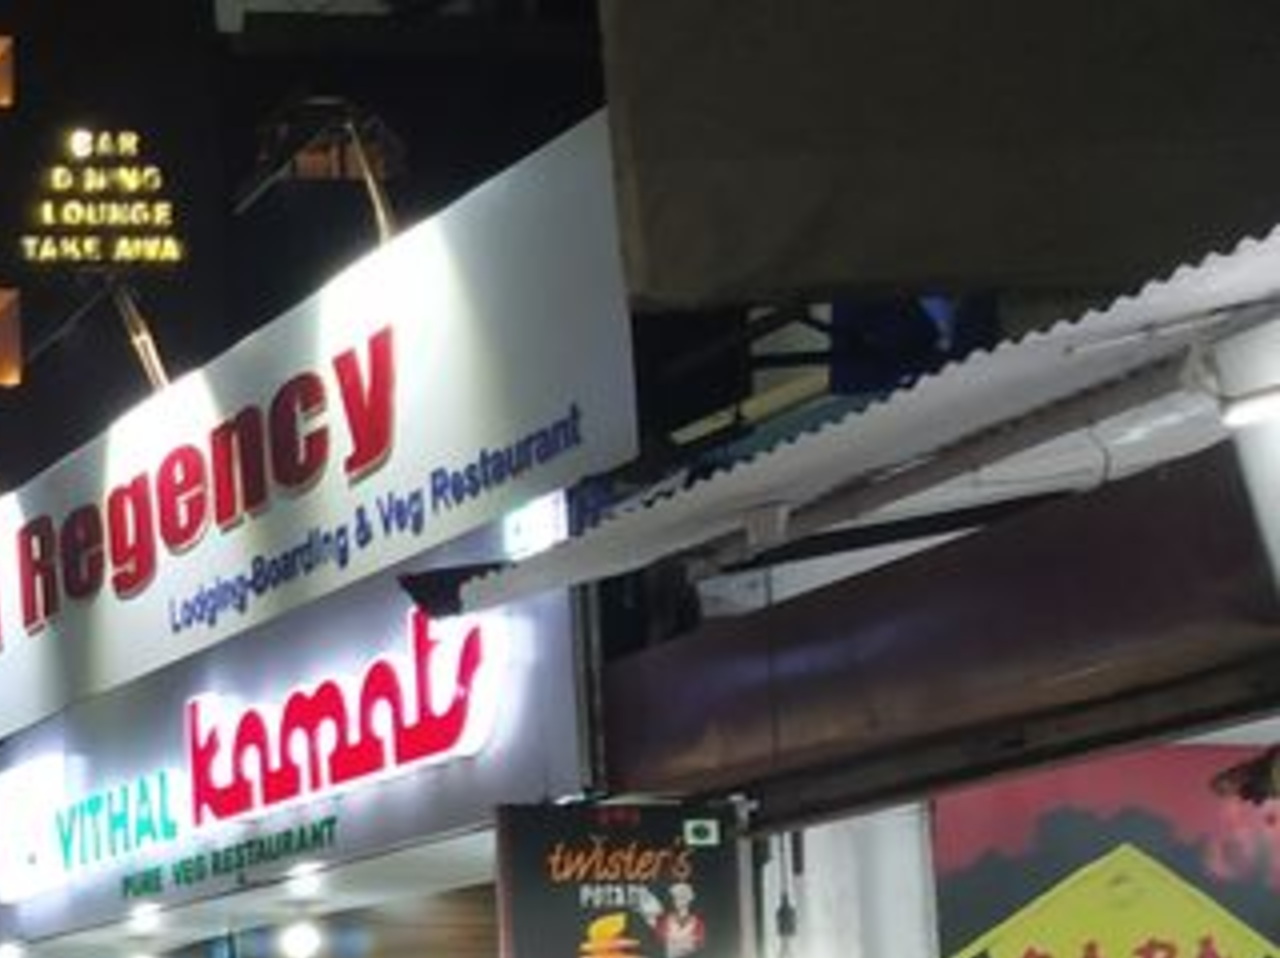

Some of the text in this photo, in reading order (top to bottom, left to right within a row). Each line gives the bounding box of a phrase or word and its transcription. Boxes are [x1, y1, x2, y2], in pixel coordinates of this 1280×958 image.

[69, 129, 139, 158] BAR
[20, 236, 101, 262] TAKE
[41, 199, 174, 225] LOUNGE
[17, 325, 395, 637] Regency
[356, 506, 372, 548] &
[377, 489, 424, 536] Veg
[430, 403, 583, 512] Restaurant
[54, 769, 178, 871] VITHAL
[122, 815, 338, 899] PURE VEG RESTAURANT
